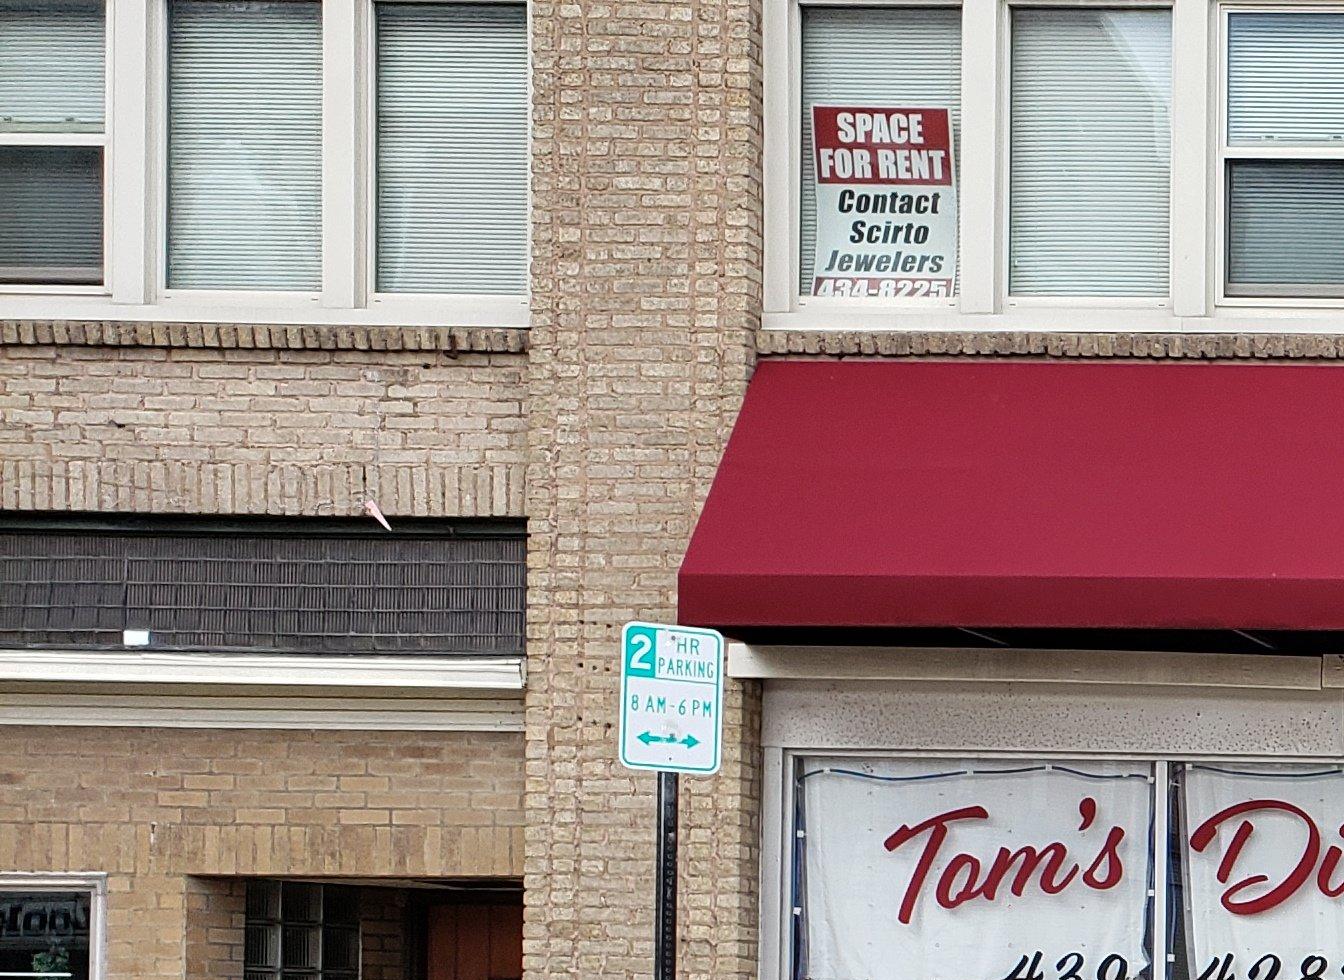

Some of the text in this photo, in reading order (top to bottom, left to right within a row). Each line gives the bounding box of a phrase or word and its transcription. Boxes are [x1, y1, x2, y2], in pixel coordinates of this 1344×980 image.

[837, 112, 924, 144] SPACE
[820, 148, 945, 180] FOR RENT
[838, 189, 941, 215] Contact
[849, 220, 930, 244] Scirto
[824, 250, 944, 274] Jewelers
[630, 633, 652, 670] 2
[677, 637, 700, 656] HR
[658, 657, 714, 680] PARKING
[631, 694, 639, 711] 8
[692, 699, 712, 718] PM
[883, 797, 1123, 925] Tom's
